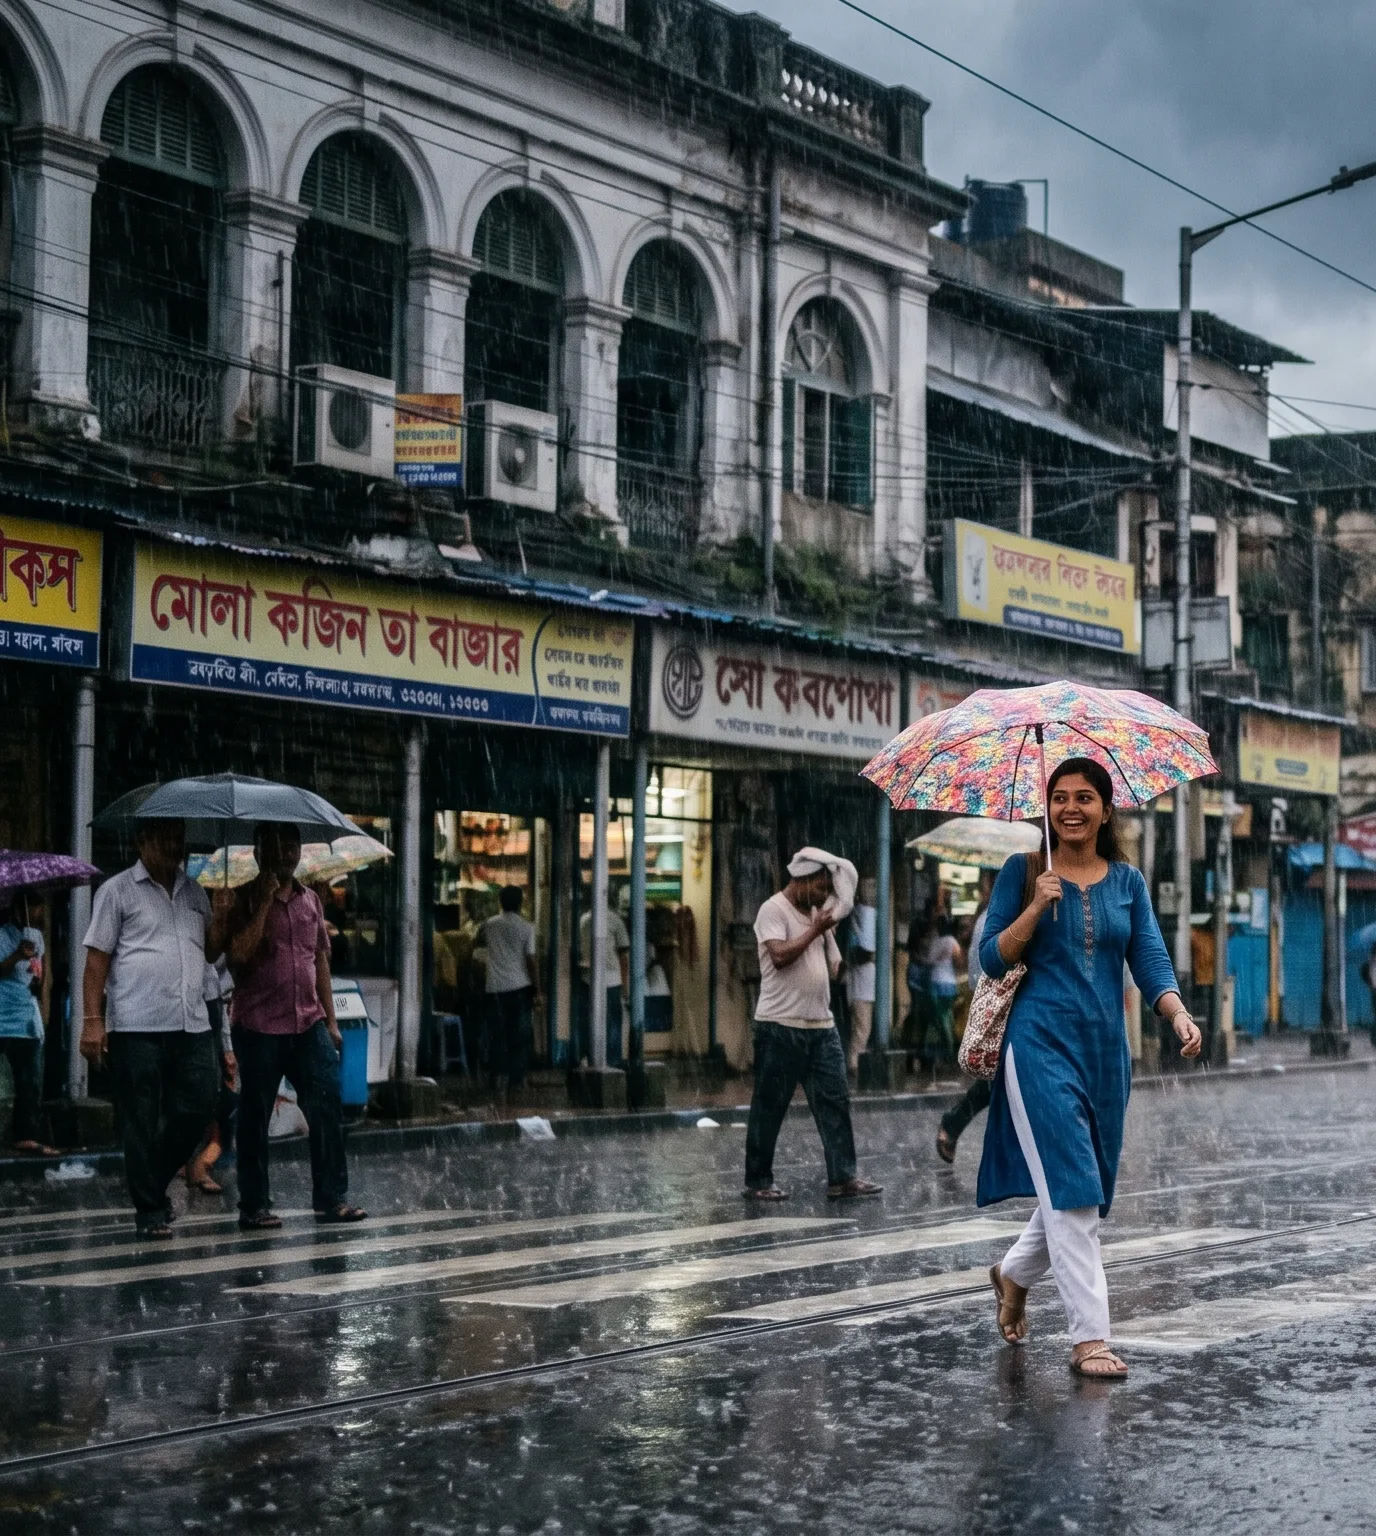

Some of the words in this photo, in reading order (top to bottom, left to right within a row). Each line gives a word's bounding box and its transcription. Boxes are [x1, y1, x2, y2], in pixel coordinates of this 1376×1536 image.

[150, 573, 257, 643] মোলা
[264, 575, 371, 658] কজিন
[377, 605, 420, 666] তা
[426, 613, 525, 677] বাজার
